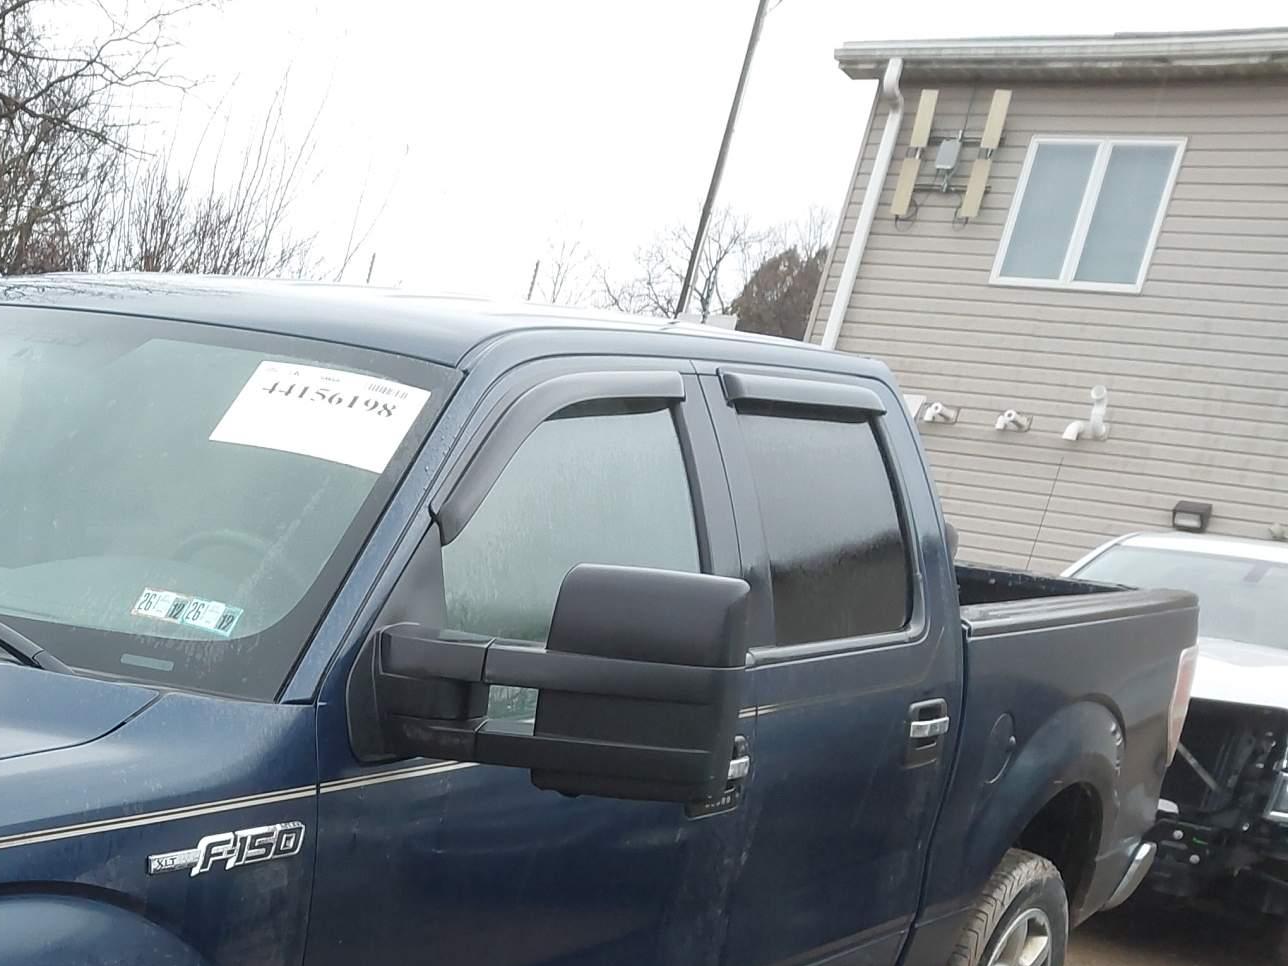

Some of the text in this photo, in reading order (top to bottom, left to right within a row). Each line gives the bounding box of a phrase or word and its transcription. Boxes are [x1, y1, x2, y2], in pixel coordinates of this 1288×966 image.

[262, 381, 397, 418] 44156198
[137, 592, 157, 611] 26
[185, 602, 205, 621] 26
[155, 823, 305, 875] XLT F-150
